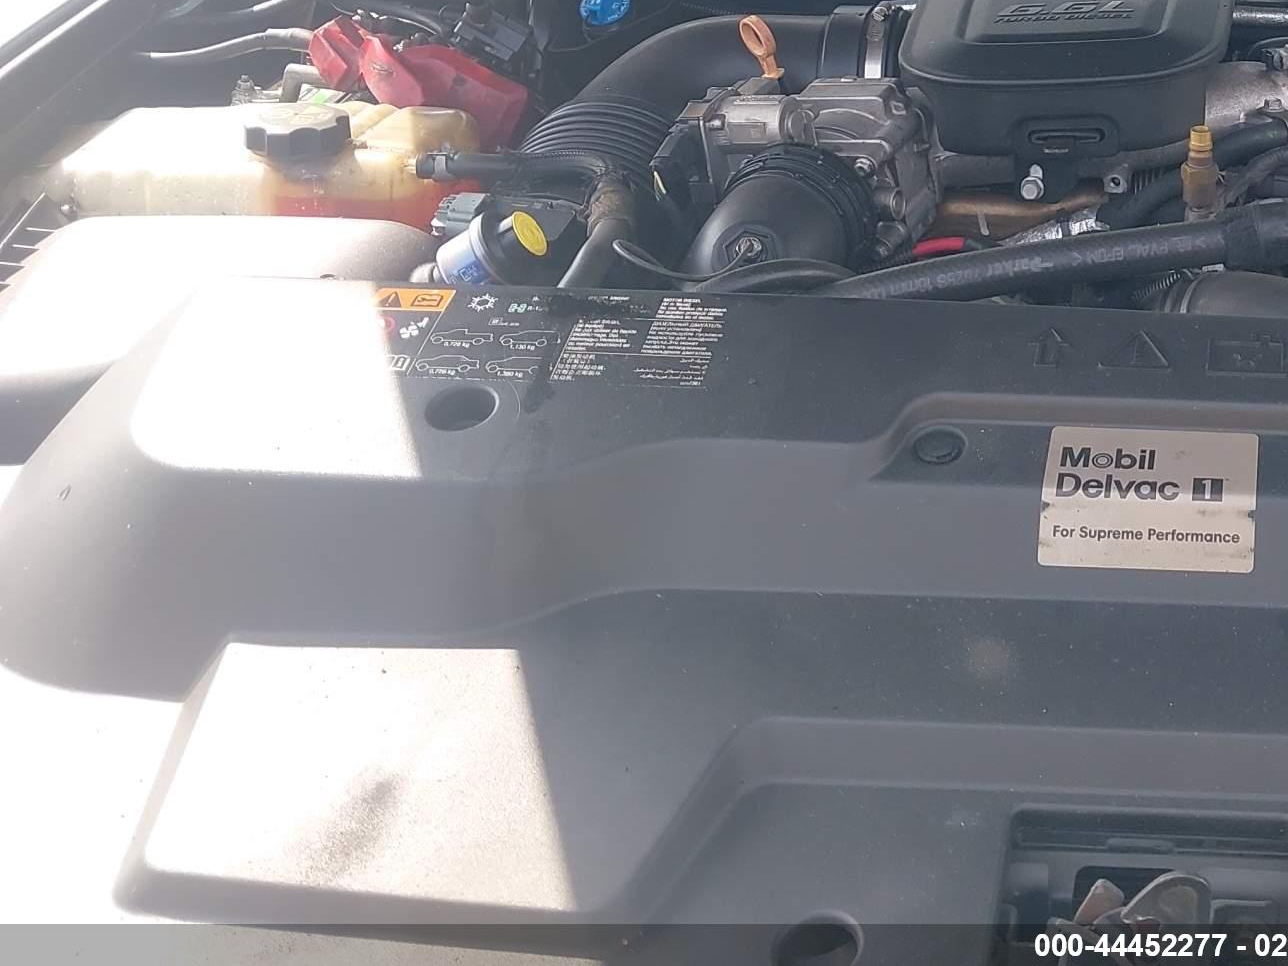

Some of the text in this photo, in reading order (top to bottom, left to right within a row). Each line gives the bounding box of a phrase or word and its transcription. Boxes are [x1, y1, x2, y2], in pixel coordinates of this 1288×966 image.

[1060, 446, 1156, 470] Mobil
[1055, 472, 1180, 501] Delvac
[1053, 525, 1240, 544] For Supreme Performance
